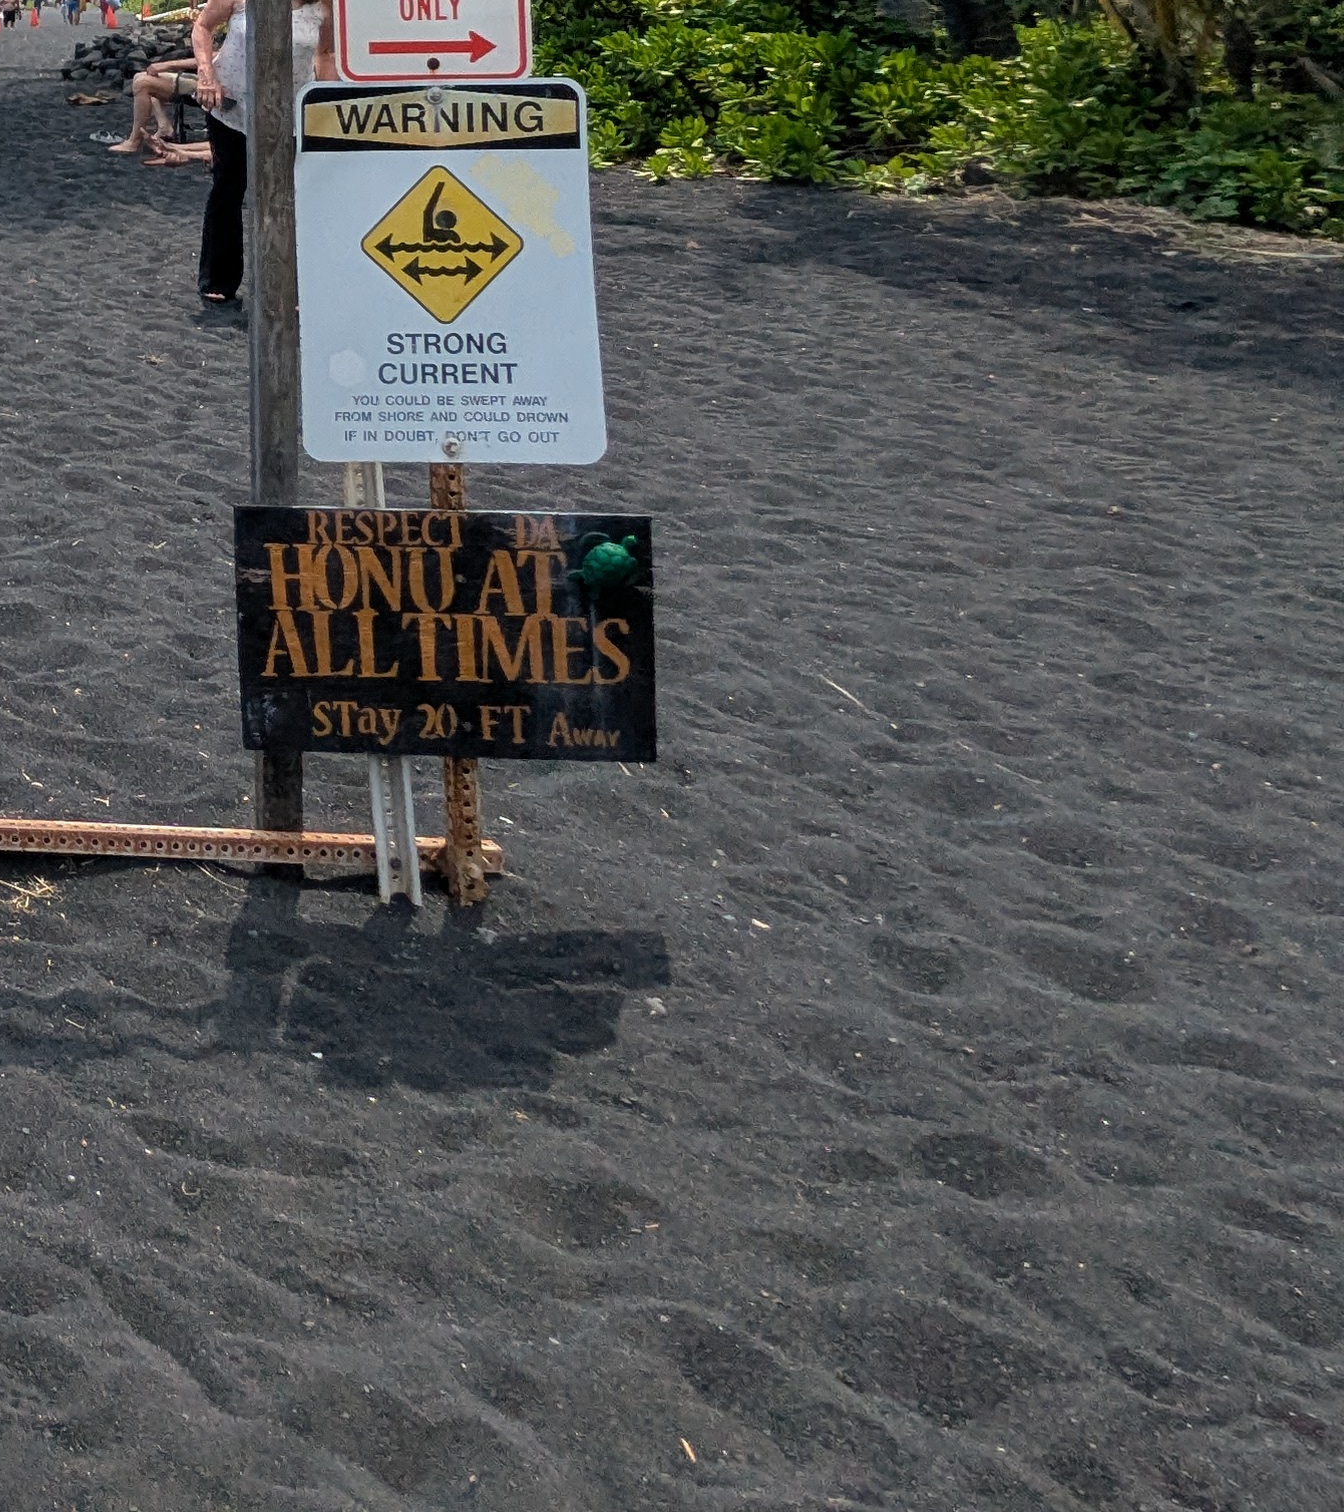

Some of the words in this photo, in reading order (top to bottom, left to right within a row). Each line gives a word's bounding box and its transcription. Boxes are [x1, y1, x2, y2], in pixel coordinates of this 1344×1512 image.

[335, 101, 545, 134] WARNING
[387, 333, 508, 354] STRONG
[378, 362, 518, 385] CURRENT
[352, 395, 379, 405] YOU
[385, 395, 430, 405] COULD
[436, 396, 454, 405] BE
[460, 396, 506, 405] SWEPT
[512, 396, 547, 405] AWAY
[334, 411, 371, 421] FROM
[378, 411, 424, 421] SHORE
[430, 411, 457, 421] AND
[463, 411, 510, 421] COULD
[516, 412, 568, 422] DROWN
[344, 430, 357, 441] IF
[363, 430, 377, 441] IN
[498, 431, 521, 442] GO
[528, 431, 559, 442] OUT
[307, 511, 466, 547] RESPECT
[514, 515, 560, 550] DA
[265, 543, 458, 613] HONU
[478, 550, 567, 618] AT
[261, 609, 400, 678] ALL
[402, 612, 631, 685] TIMES
[418, 703, 457, 740] 20
[479, 705, 531, 745] FT
